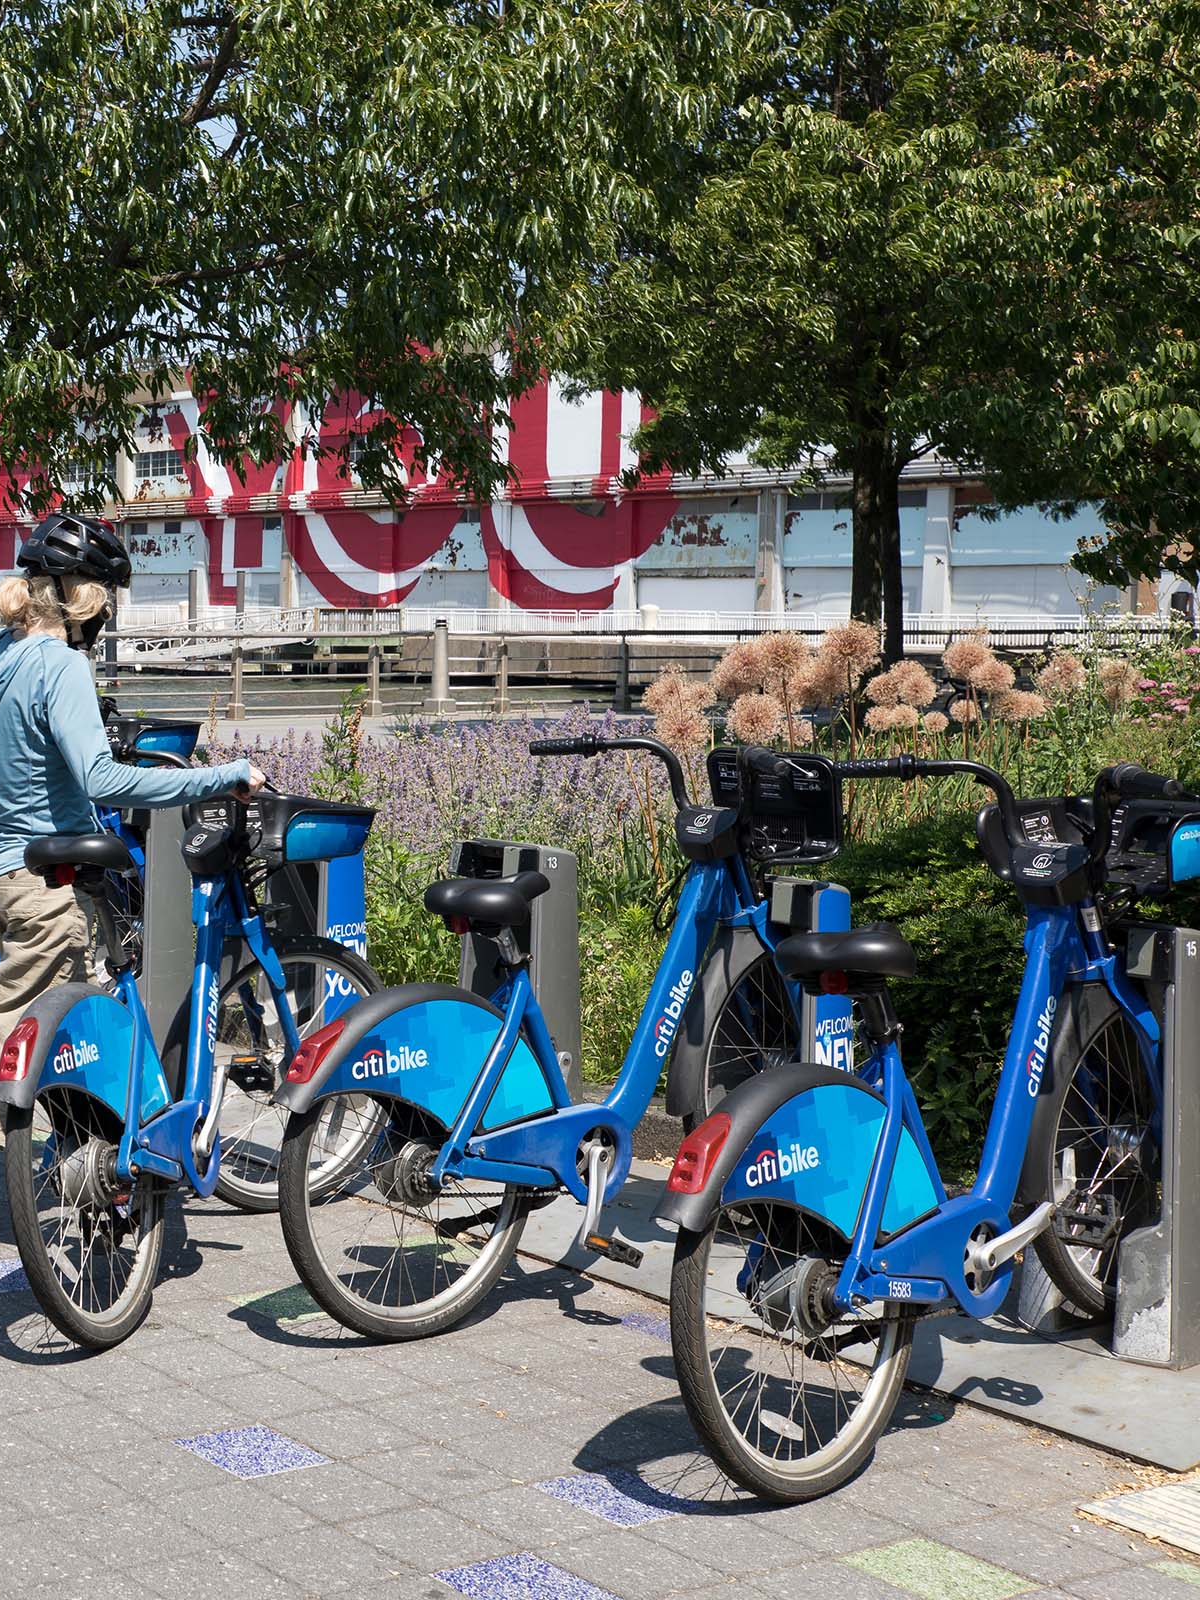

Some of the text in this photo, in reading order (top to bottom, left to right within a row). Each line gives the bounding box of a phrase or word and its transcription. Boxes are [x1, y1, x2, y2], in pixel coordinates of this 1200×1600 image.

[547, 856, 558, 869] 13
[1186, 940, 1197, 957] 15
[887, 1281, 912, 1298] 15583
